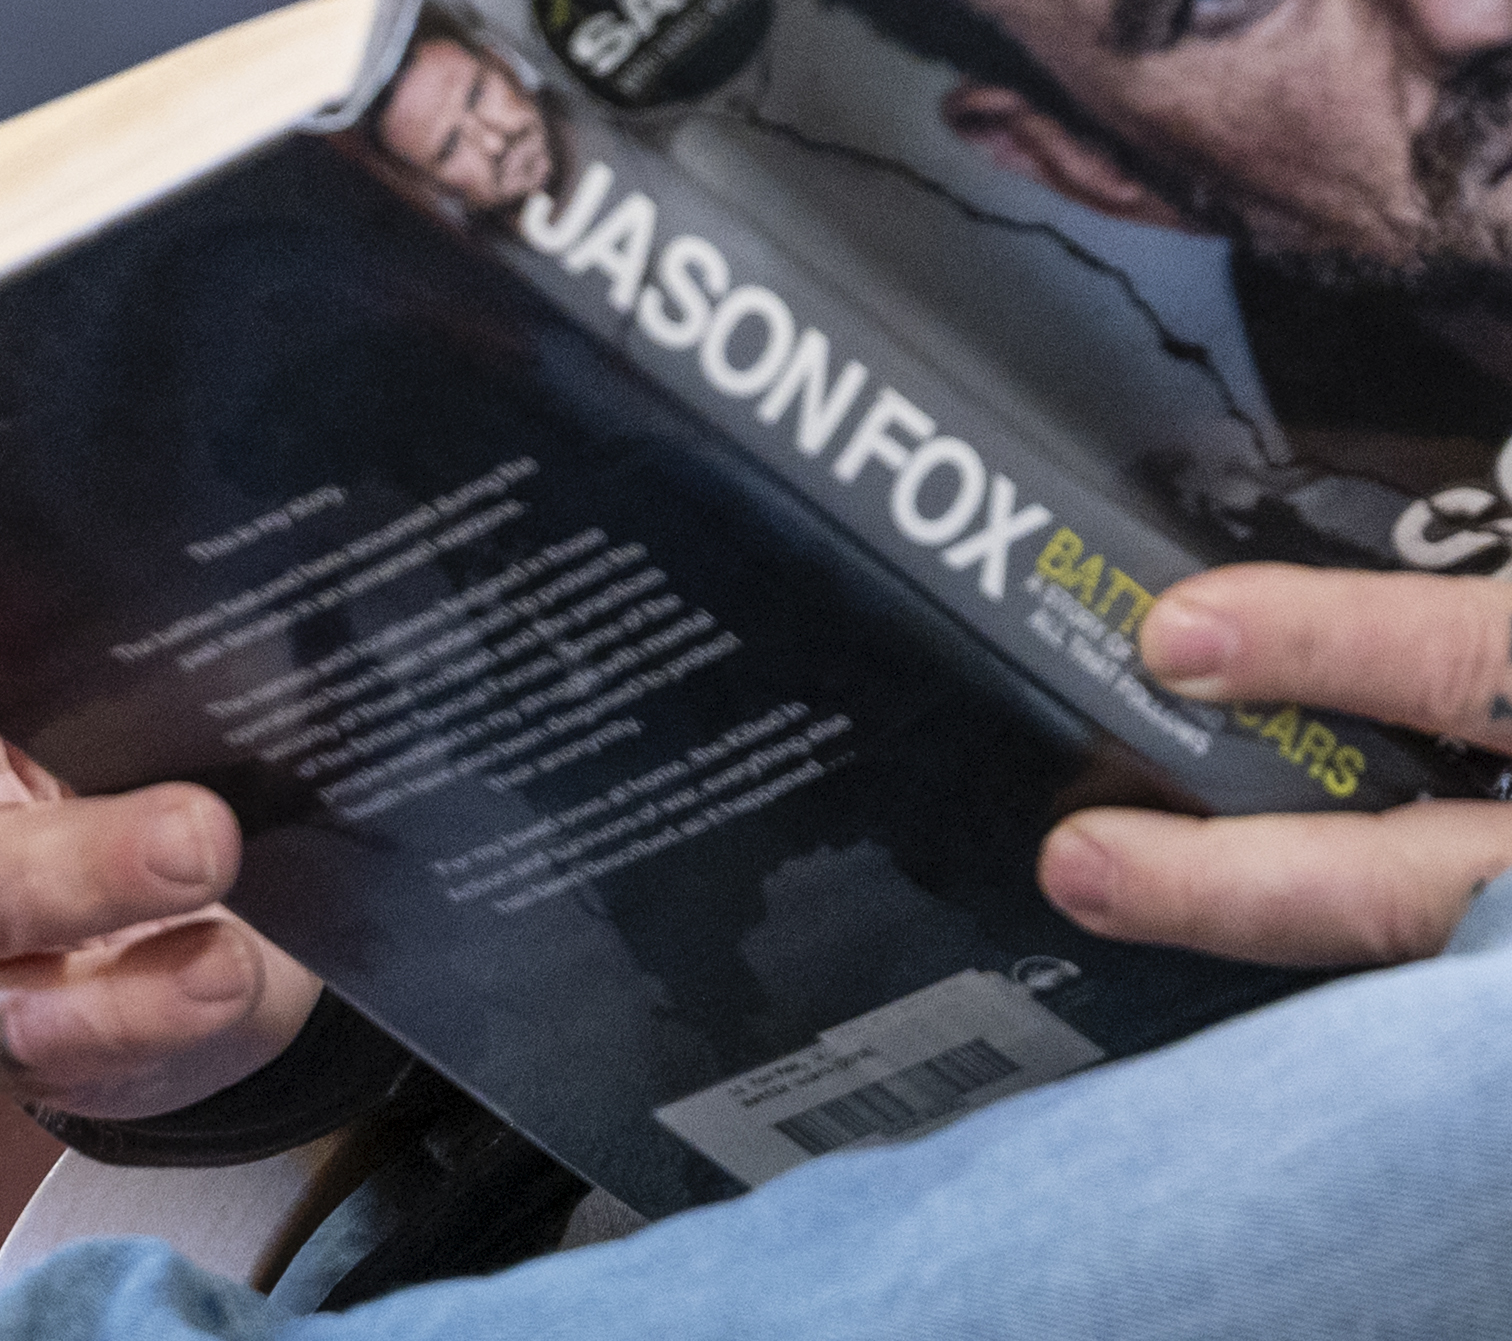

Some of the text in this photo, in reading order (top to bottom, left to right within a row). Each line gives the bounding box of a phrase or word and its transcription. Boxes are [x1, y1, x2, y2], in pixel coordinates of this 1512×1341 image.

[521, 161, 1055, 601] JASON FOX
[1038, 526, 1157, 636] BATT
